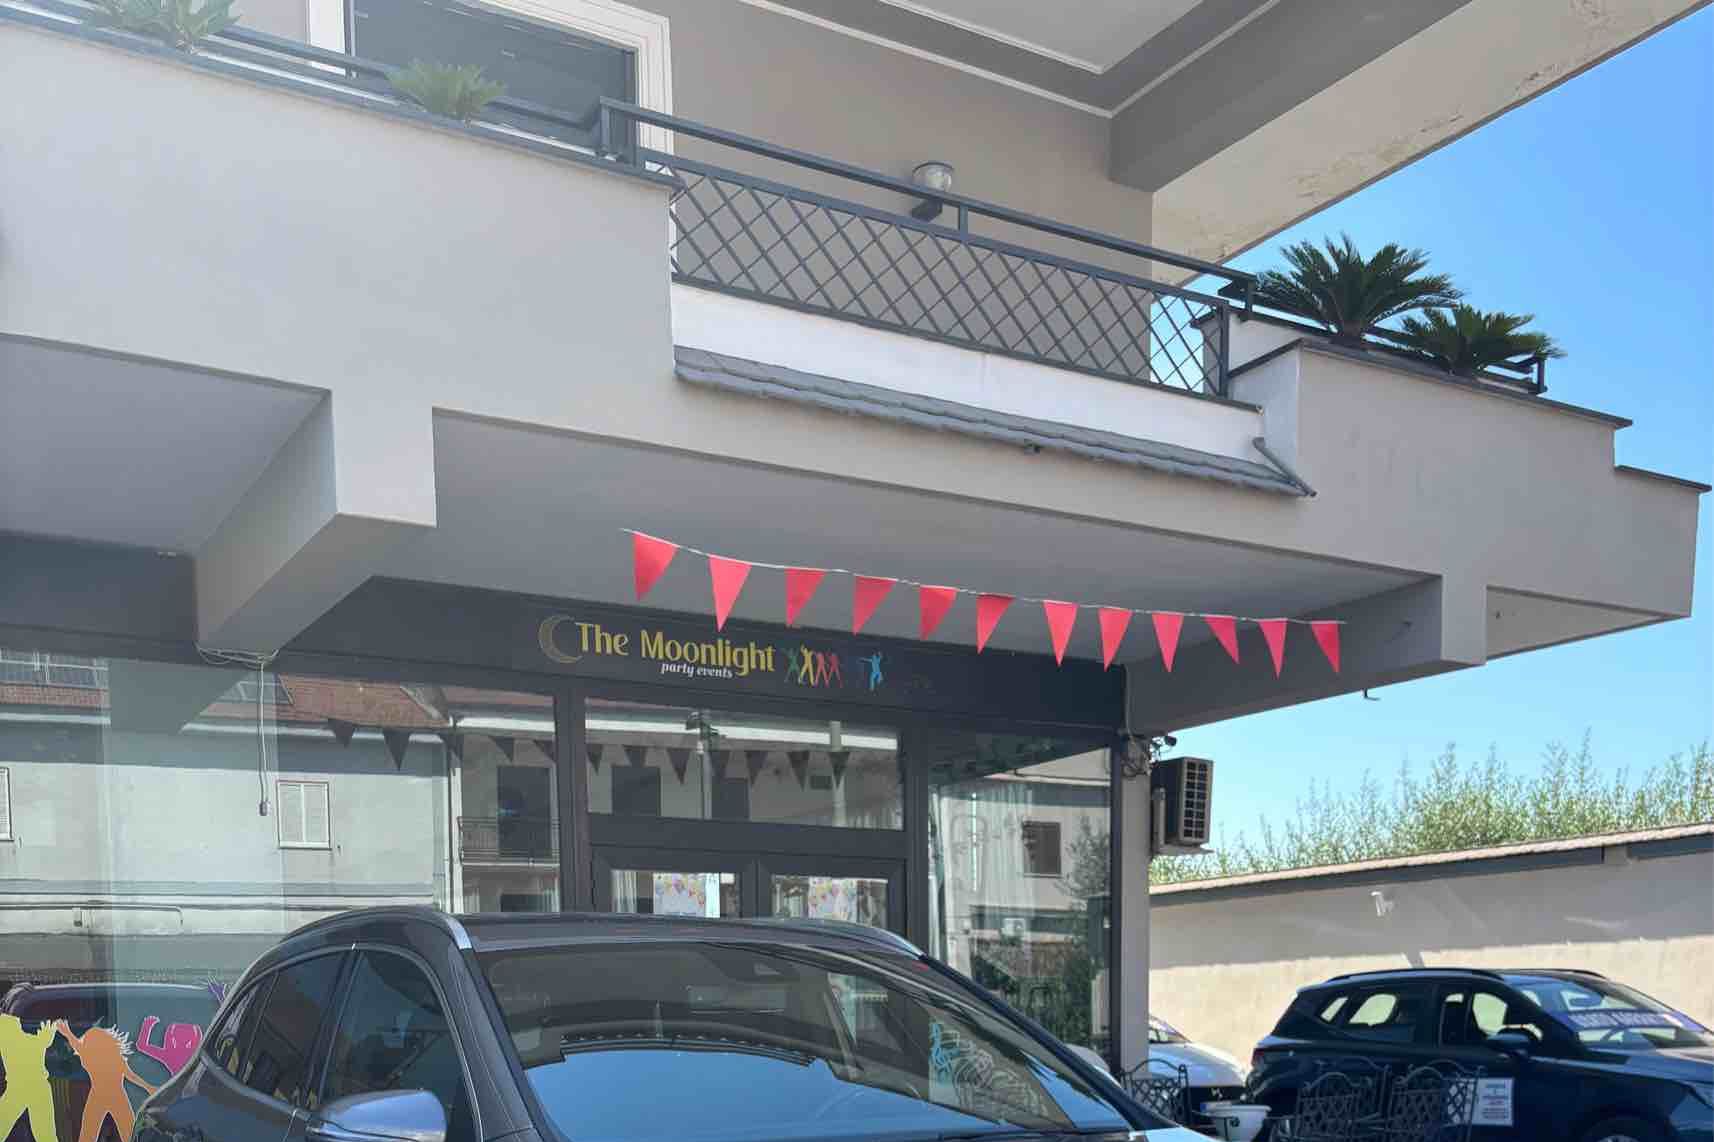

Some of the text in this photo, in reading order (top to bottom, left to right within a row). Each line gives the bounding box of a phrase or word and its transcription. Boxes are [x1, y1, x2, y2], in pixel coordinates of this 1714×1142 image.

[575, 622, 776, 677] The Moonlight
[661, 661, 733, 679] party events
